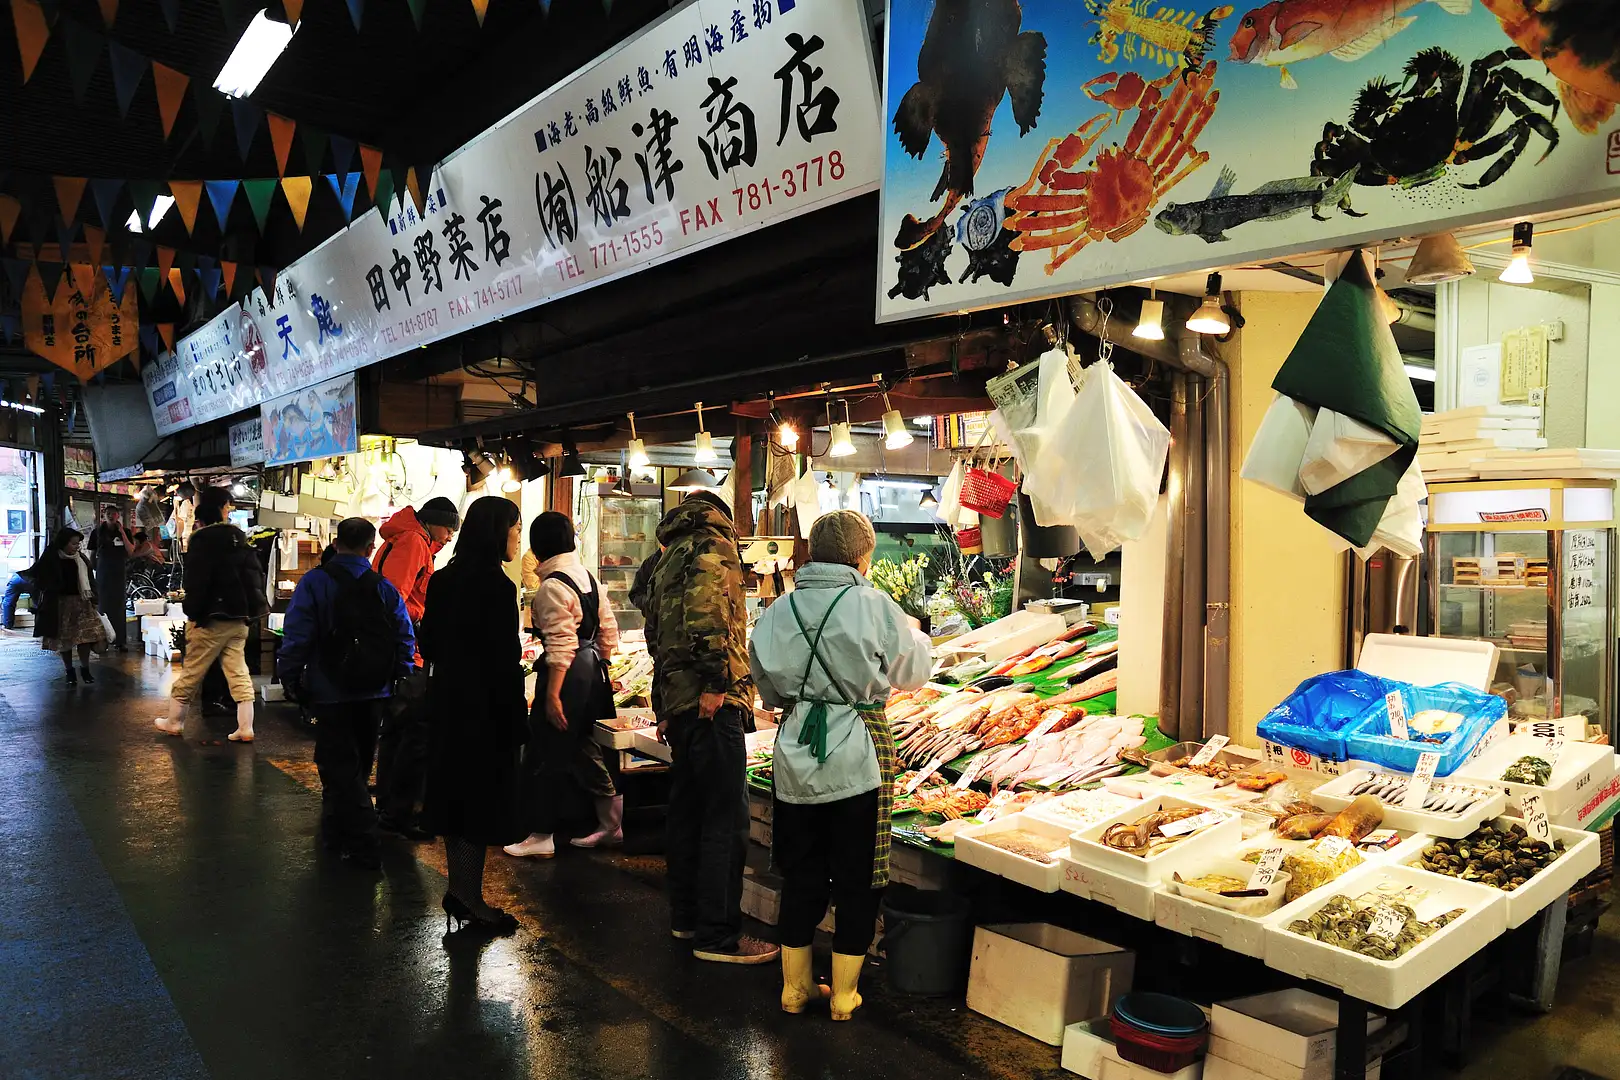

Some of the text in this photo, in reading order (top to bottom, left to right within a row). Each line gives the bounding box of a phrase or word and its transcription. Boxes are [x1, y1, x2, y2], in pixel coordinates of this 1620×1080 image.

[397, 193, 438, 232] 新鮮菜
[555, 150, 846, 282] TEL 771-1555 FAX 781-3778
[365, 195, 511, 313] 田中野菜店
[256, 278, 297, 318] 高鮮魚
[276, 293, 343, 360] 天龍
[381, 275, 523, 345] TEL 741-8787 FAX 741-5717
[320, 351, 335, 370] FAX
